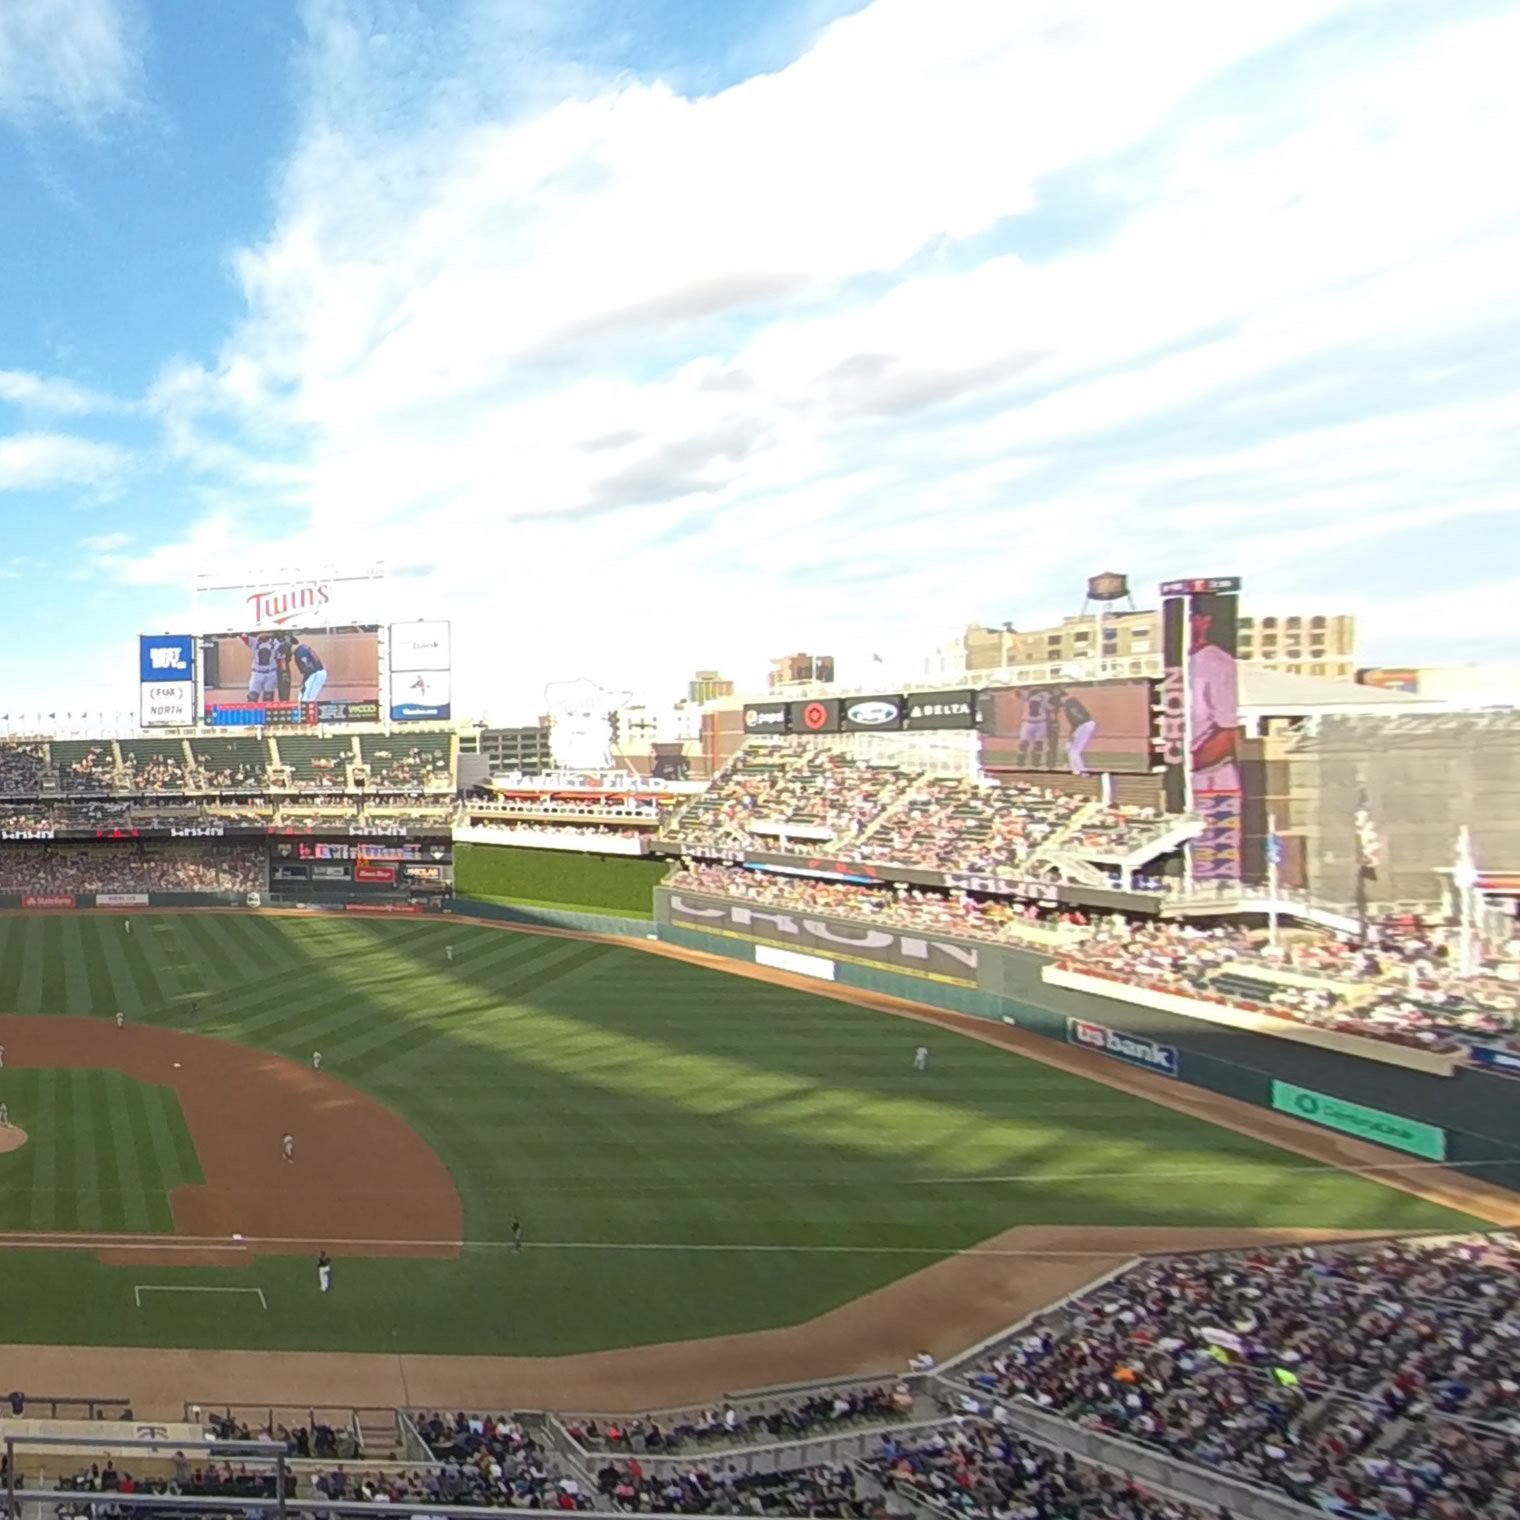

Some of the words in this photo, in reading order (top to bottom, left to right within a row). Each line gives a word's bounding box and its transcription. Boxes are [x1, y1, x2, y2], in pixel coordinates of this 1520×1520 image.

[246, 584, 329, 625] Twins
[150, 705, 183, 715] NORTH
[922, 703, 970, 717] DELTA
[1077, 1024, 1105, 1048] us
[1106, 1029, 1170, 1068] bank
